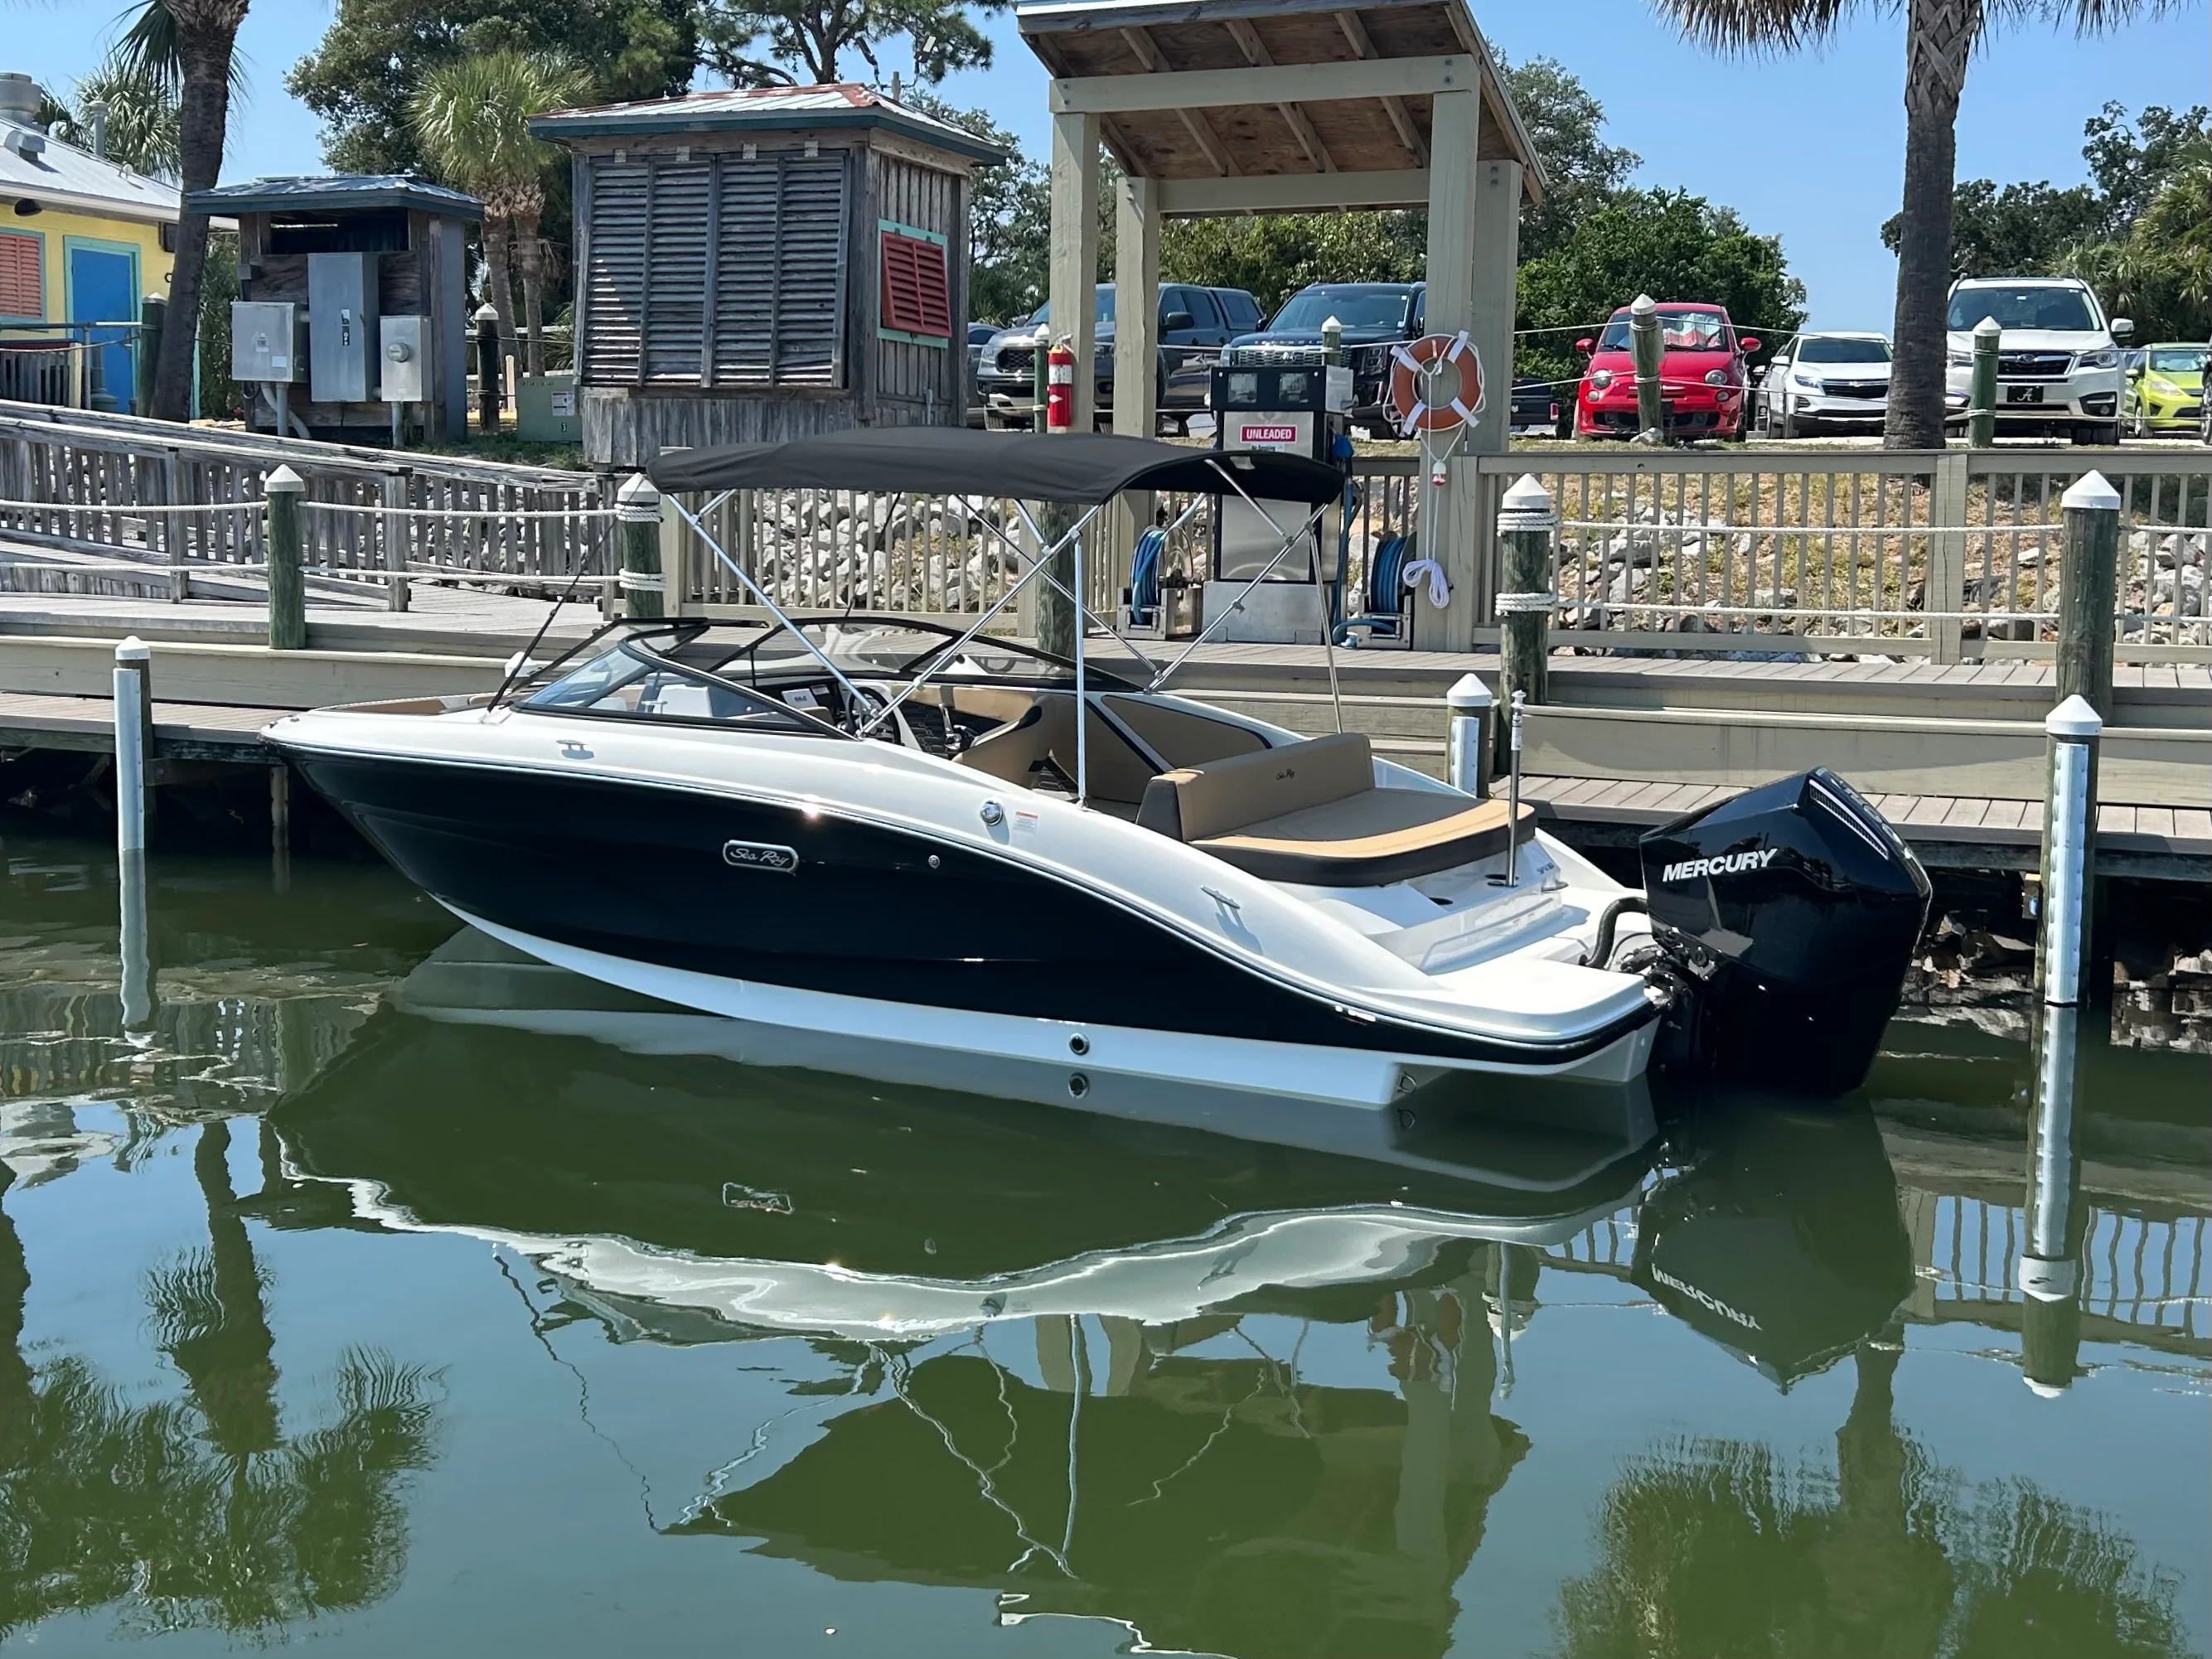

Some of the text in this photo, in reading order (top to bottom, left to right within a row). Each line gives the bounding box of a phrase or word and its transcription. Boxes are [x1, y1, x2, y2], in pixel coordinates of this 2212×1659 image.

[1246, 428, 1292, 440] UNLEADED
[729, 848, 789, 867] Sea Ray
[1662, 848, 1779, 883] MERCURY
